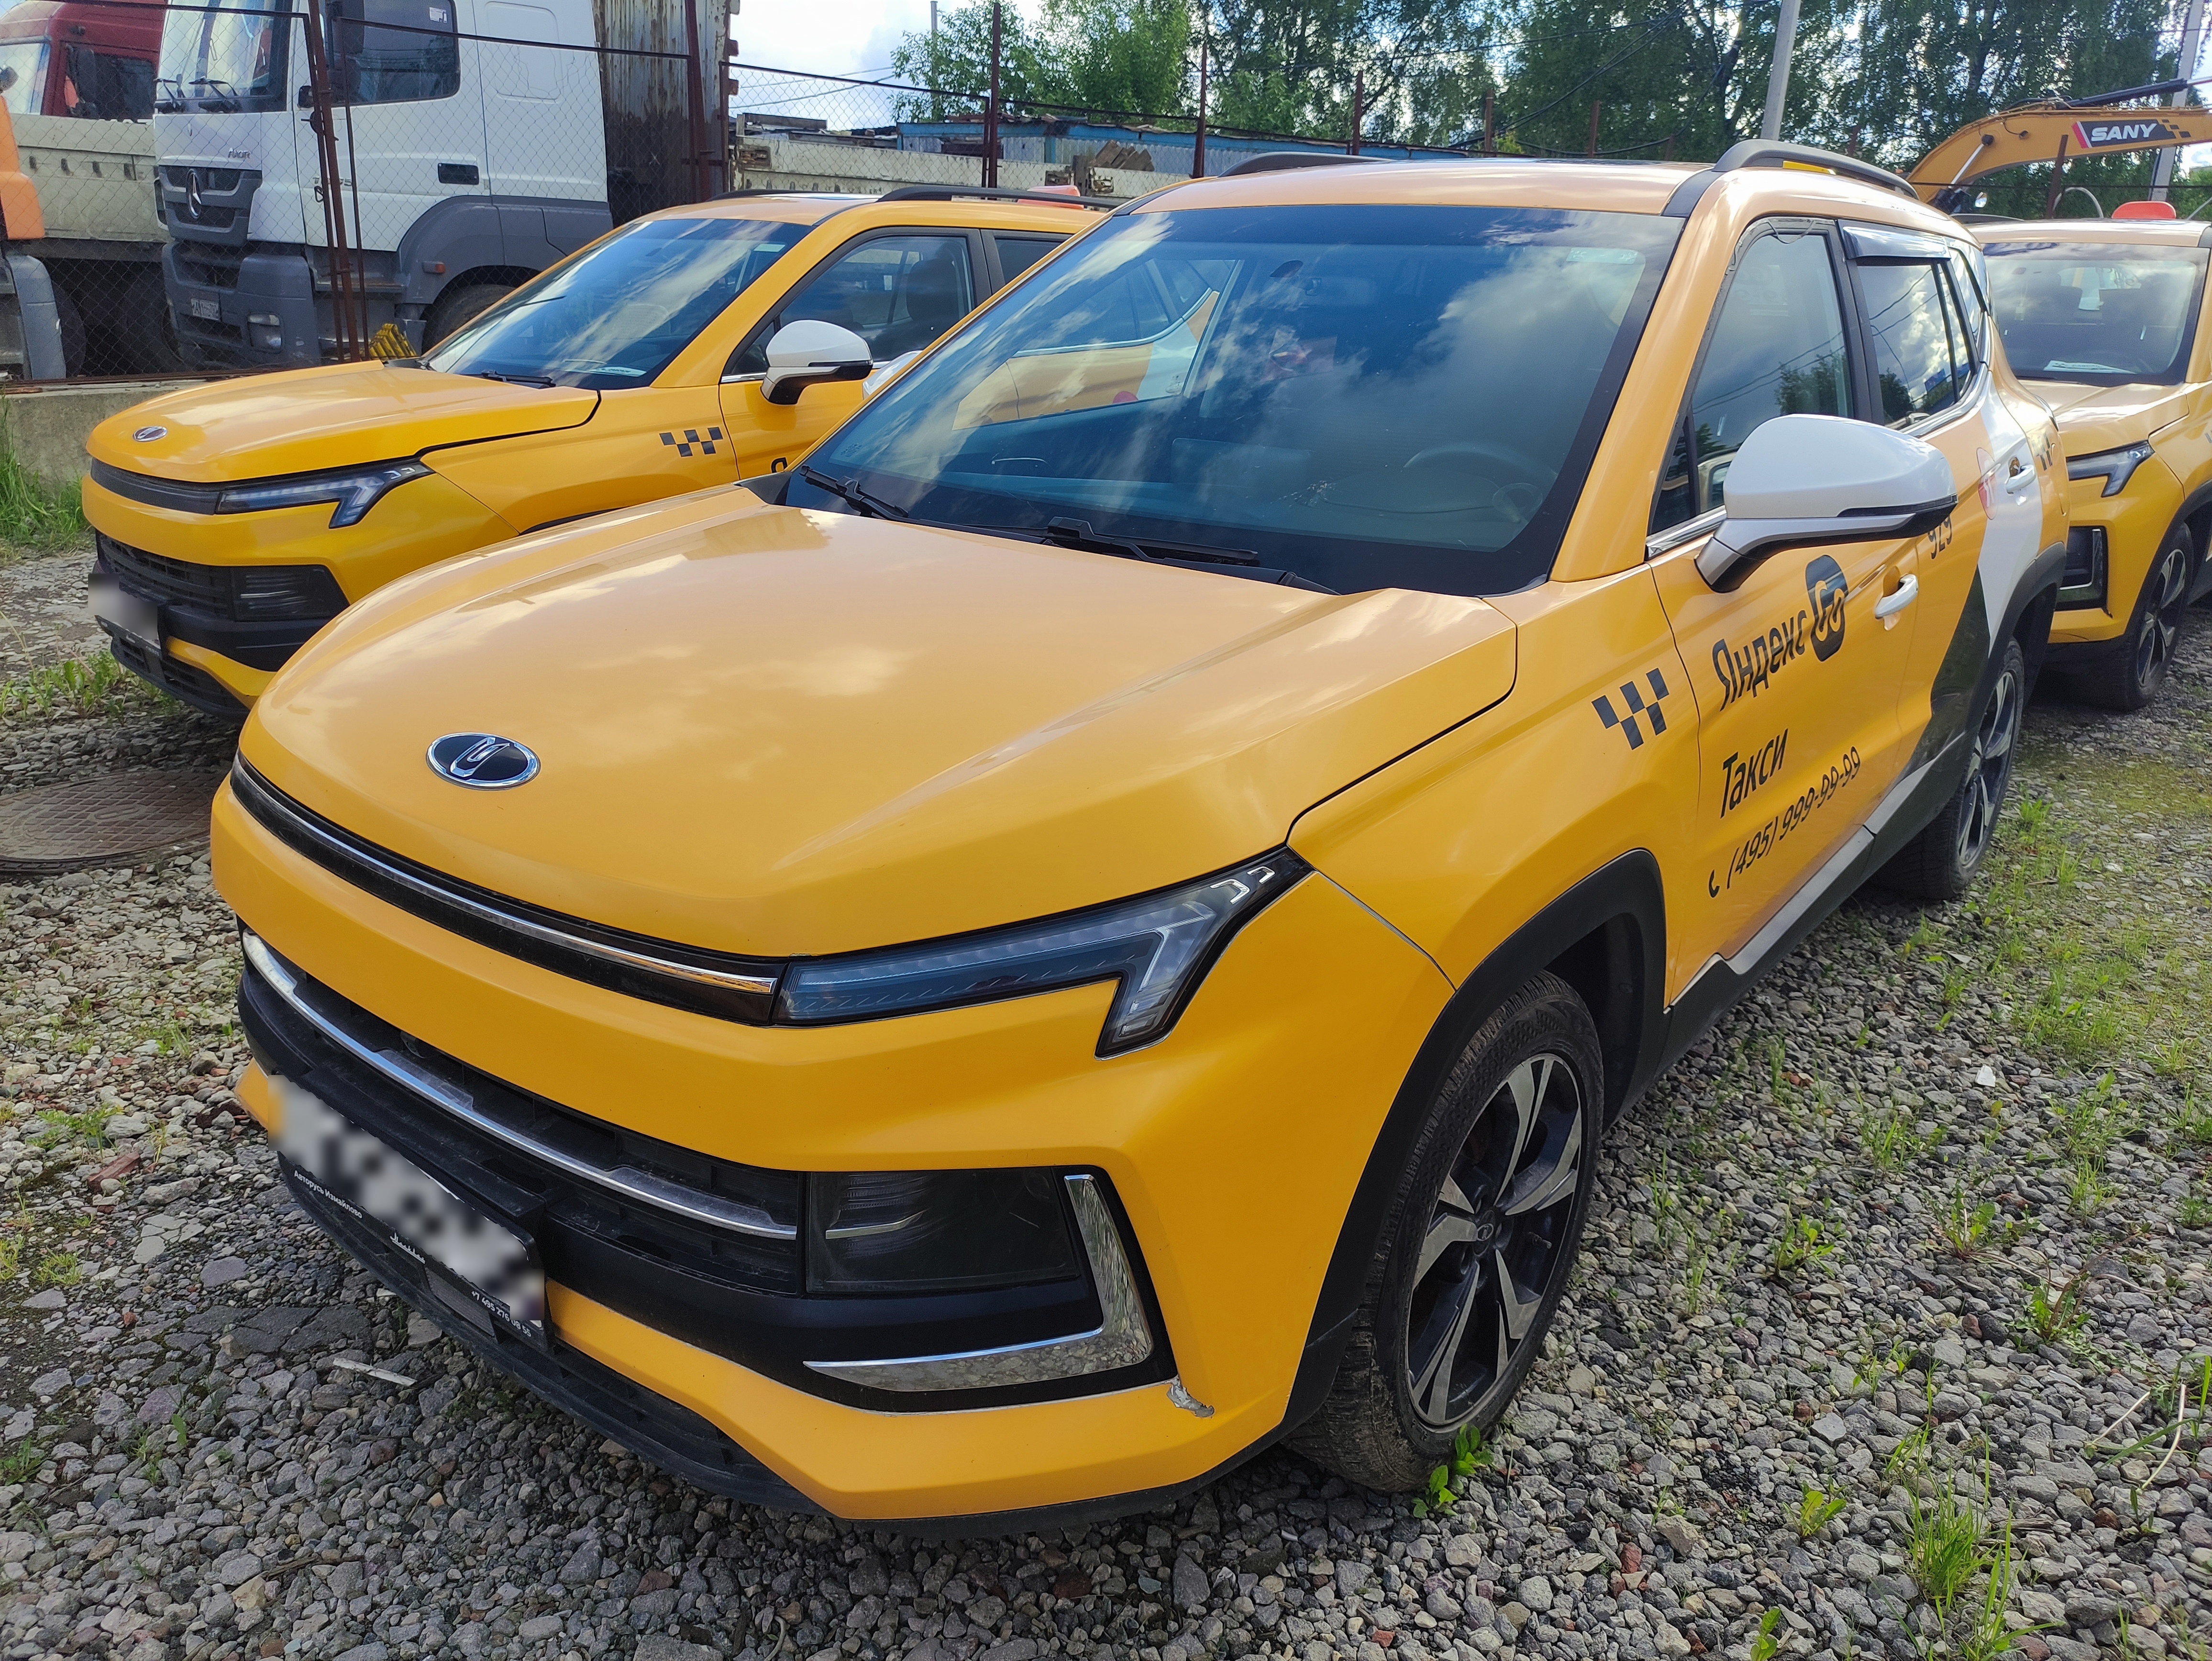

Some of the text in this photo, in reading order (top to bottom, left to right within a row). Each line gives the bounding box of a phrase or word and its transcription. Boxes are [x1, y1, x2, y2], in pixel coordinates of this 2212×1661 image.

[2091, 123, 2157, 142] SANY
[1712, 581, 1845, 711] Яндекс Go
[1720, 728, 1788, 819] Такси
[1726, 746, 1861, 889] (495) 999-99-99
[294, 1170, 363, 1218] Авторусь Измайлово
[481, 1297, 496, 1312] 495
[496, 1307, 510, 1322] 276
[522, 1324, 531, 1337] 55
